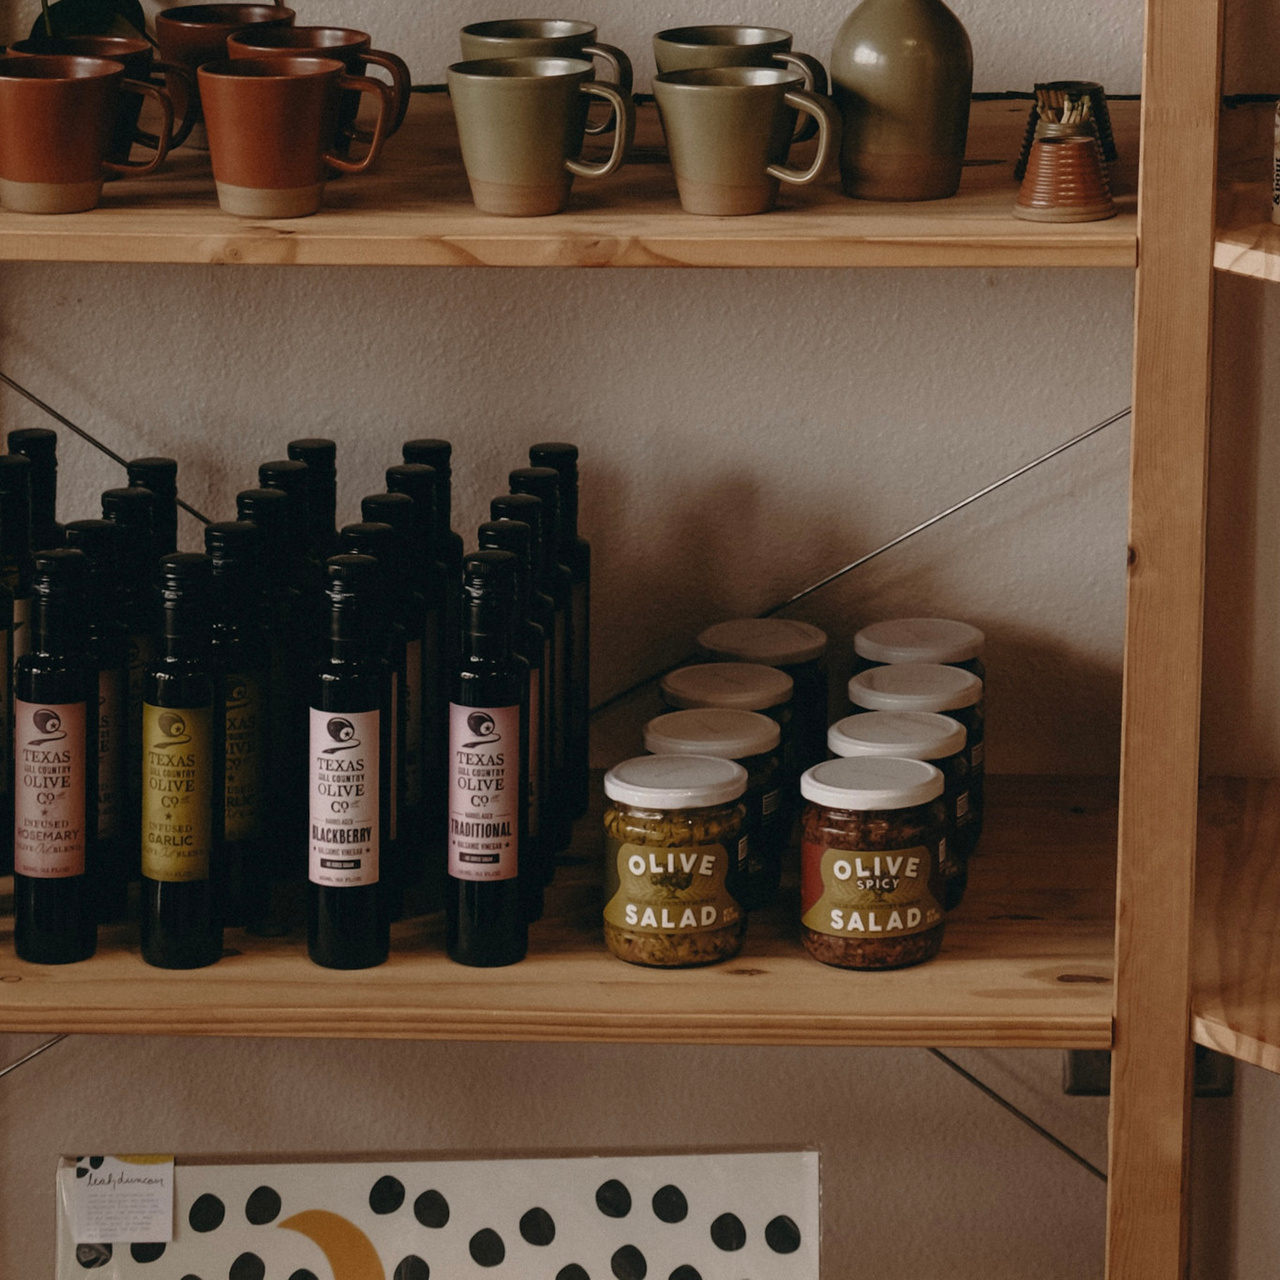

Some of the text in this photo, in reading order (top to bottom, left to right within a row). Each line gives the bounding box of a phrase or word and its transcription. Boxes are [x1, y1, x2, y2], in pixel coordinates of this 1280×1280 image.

[23, 749, 71, 764] TEXAS
[149, 751, 195, 767] TEXAS
[456, 751, 505, 767] TEXAS
[38, 765, 71, 774] COUNTRY
[317, 757, 365, 772] TEXAS
[163, 769, 195, 778] COUNTRY
[332, 773, 365, 782] COUNTRY
[472, 768, 505, 777] COUNTRY
[23, 775, 71, 788] OLIVE
[149, 779, 195, 792] OLIVE
[457, 776, 505, 791] OLIVE
[318, 782, 365, 797] OLIVE
[24, 819, 69, 829] INFUSED
[149, 824, 193, 834] INFUSED
[451, 818, 512, 839] TRADITIONAL
[18, 827, 80, 841] ROSEMARY
[148, 833, 193, 847] GARLIC
[312, 824, 373, 844] BLACKBERRY
[628, 853, 716, 876] OLIVE
[833, 856, 920, 881] OLIVE
[856, 878, 900, 890] SPICY
[625, 903, 717, 929] SALAD
[830, 907, 922, 932] SALAD
